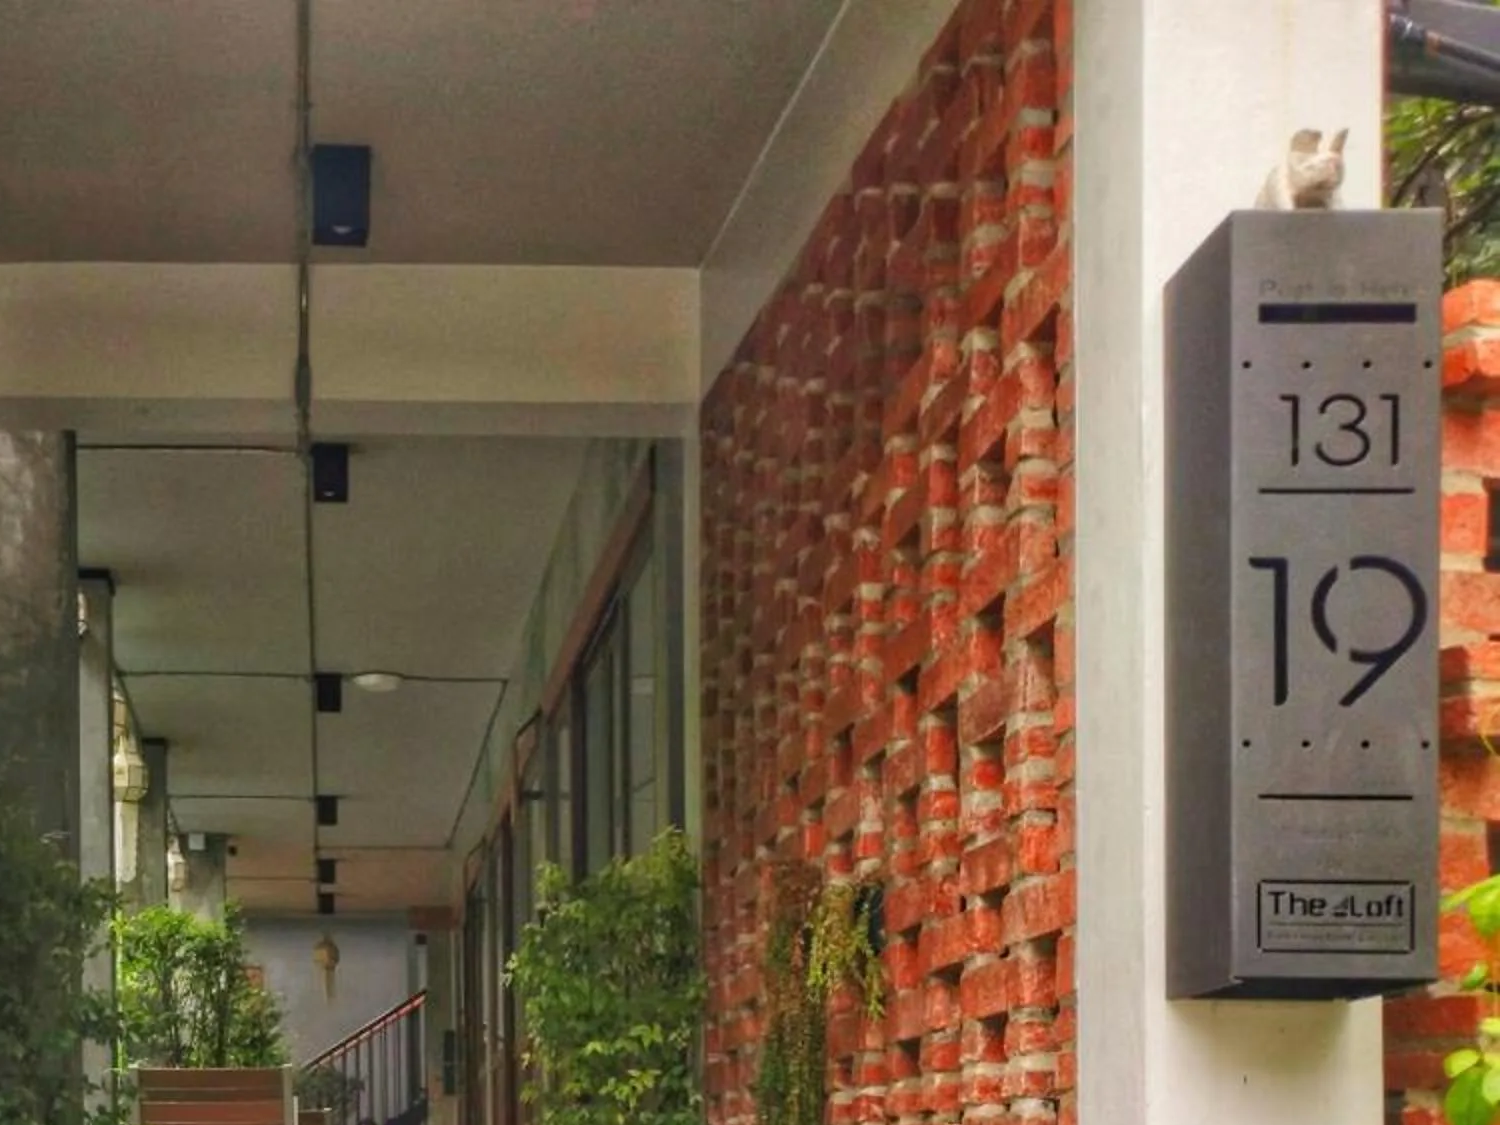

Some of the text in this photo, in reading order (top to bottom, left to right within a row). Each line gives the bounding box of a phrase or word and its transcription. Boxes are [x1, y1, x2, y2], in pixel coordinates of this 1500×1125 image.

[1279, 394, 1400, 466] 131
[1248, 556, 1428, 707] 19
[1267, 890, 1406, 918] The Loft
